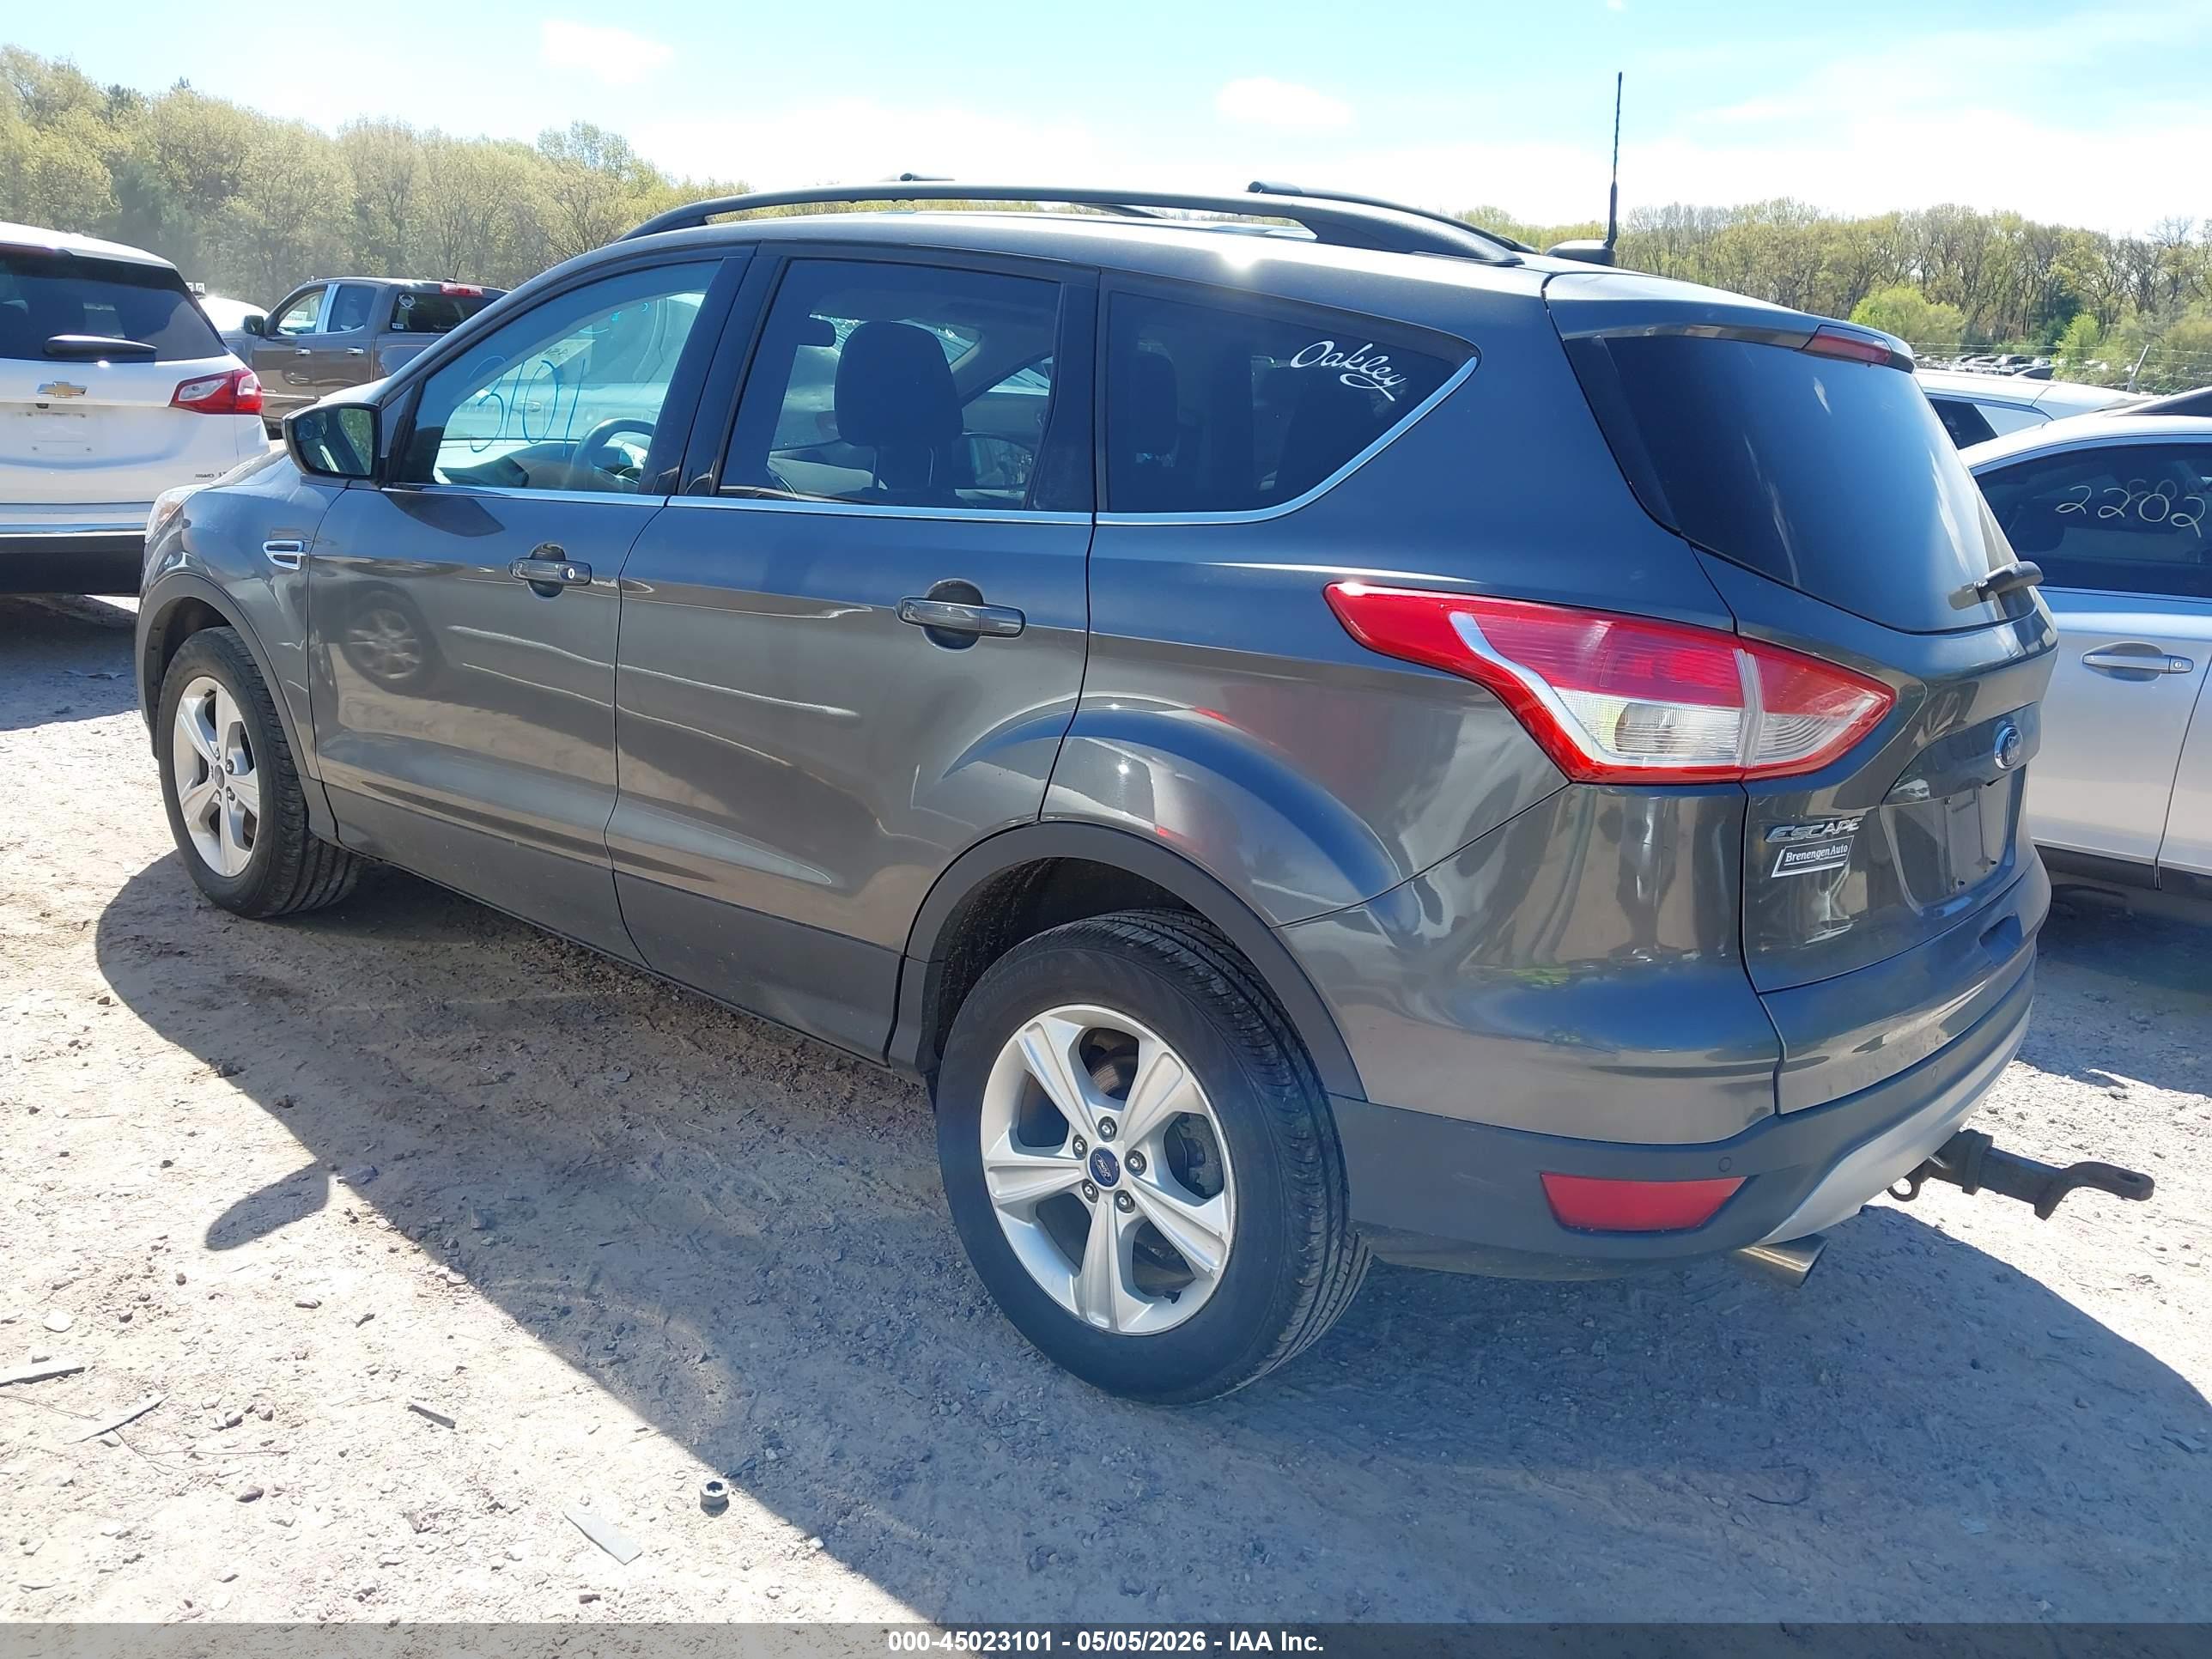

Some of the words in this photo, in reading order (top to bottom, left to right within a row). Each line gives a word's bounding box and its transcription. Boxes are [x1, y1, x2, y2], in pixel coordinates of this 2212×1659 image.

[1290, 340, 1407, 402] Oakley
[2055, 485, 2206, 538] 2202
[1765, 817, 1863, 842] ESCAPE
